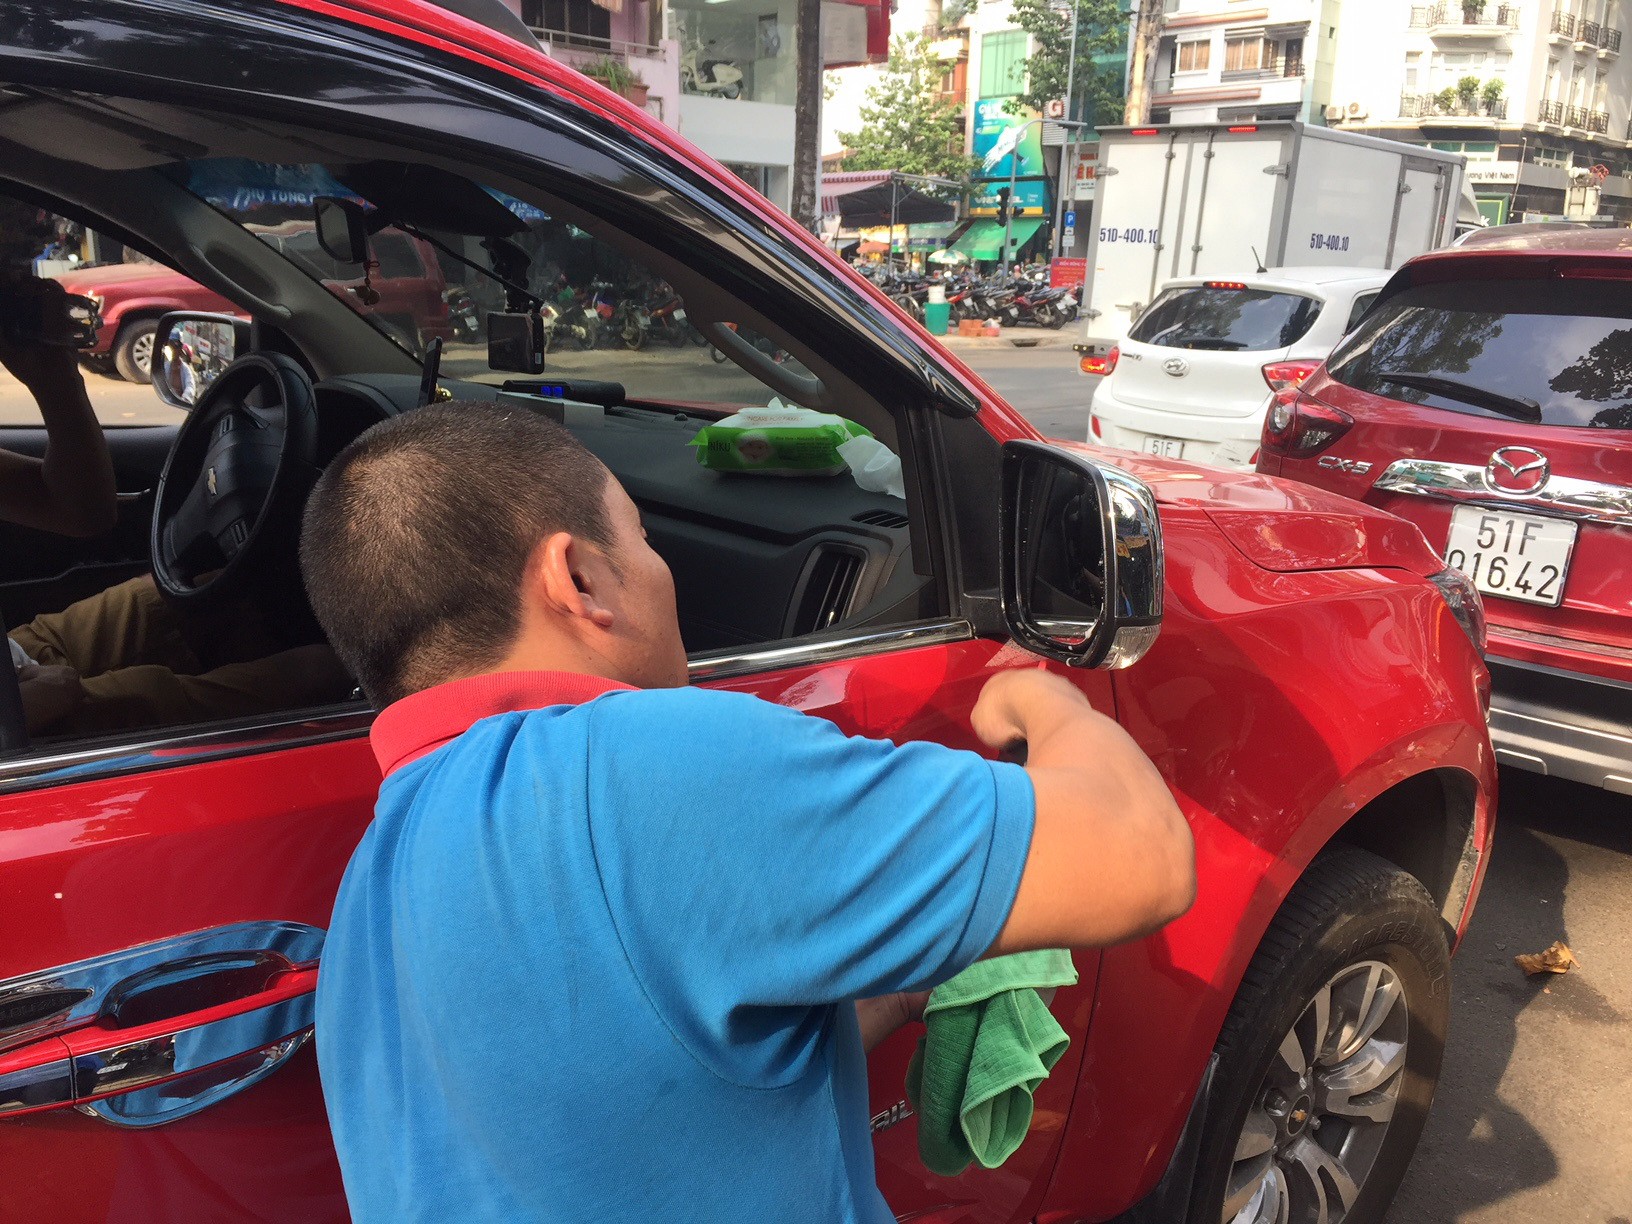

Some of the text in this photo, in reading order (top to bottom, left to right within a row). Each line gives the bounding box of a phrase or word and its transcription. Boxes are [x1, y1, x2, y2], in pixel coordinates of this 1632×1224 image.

[1100, 228, 1158, 243] 51D-400.10
[1310, 233, 1350, 251] 51D-400.10
[1152, 440, 1173, 457] 51F
[1318, 455, 1374, 475] CX-5
[1477, 515, 1543, 556] 51F
